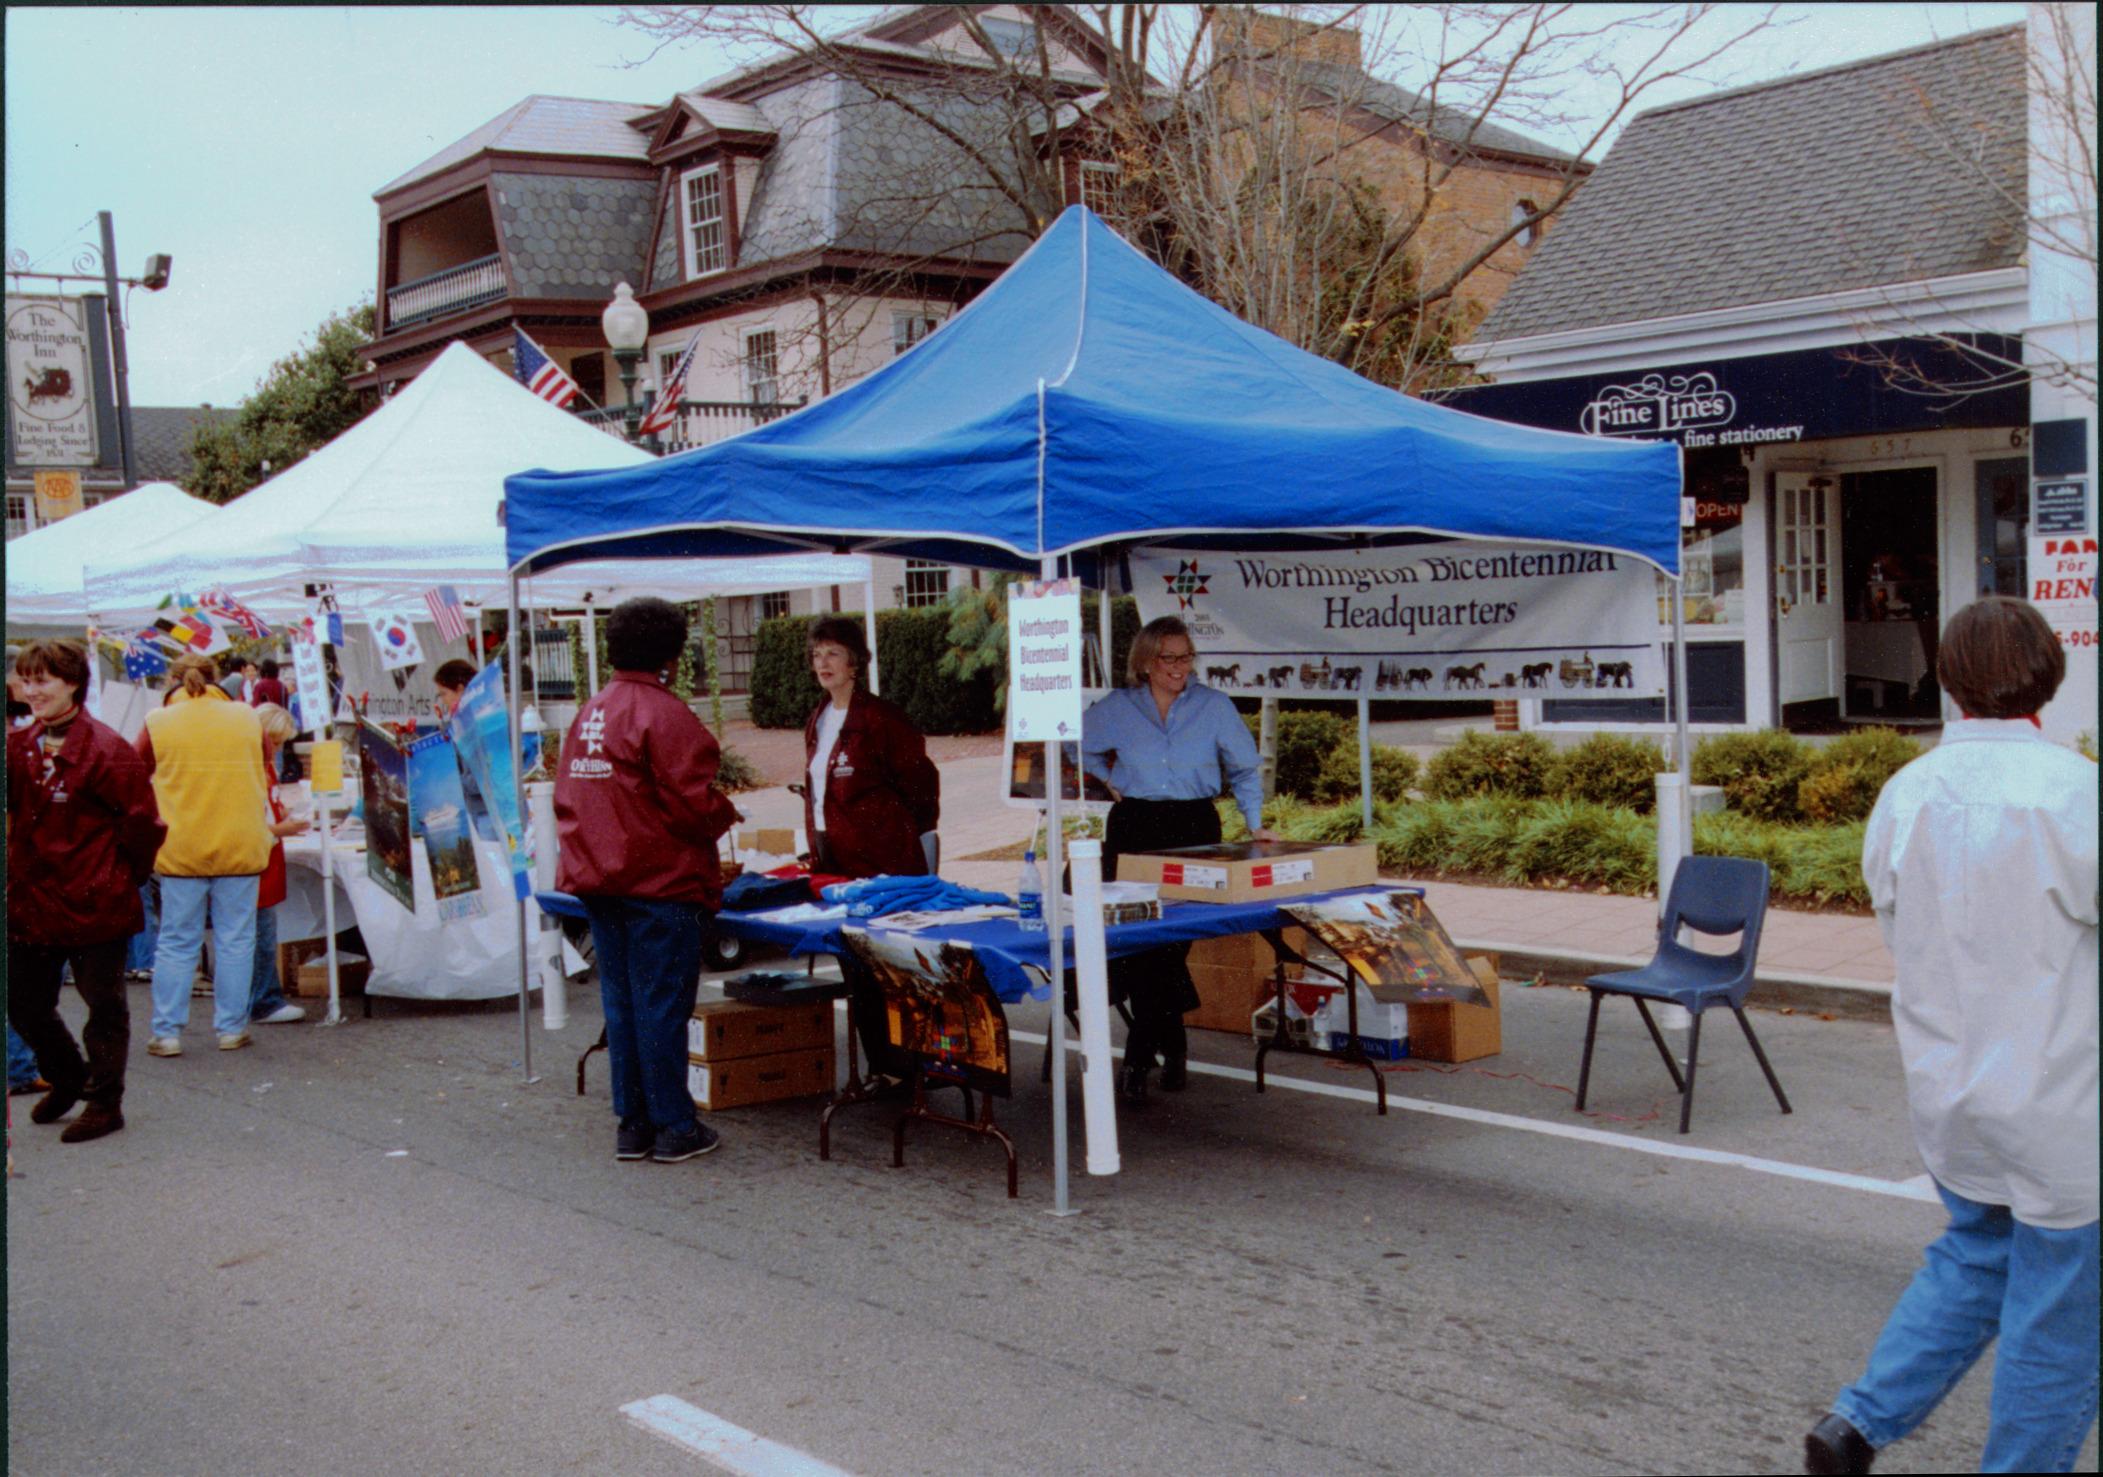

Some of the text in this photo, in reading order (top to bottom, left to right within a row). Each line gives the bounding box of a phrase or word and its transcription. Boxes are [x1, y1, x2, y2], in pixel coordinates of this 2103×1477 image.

[28, 312, 56, 326] The
[7, 328, 81, 348] Worthington
[34, 343, 57, 358] Inn
[1588, 396, 1726, 436] Fine Lines
[18, 422, 43, 433] Fine
[47, 423, 75, 433] Food
[1684, 424, 1804, 449] fine stationery
[18, 435, 58, 448] Lodging
[1871, 438, 1911, 456] 657
[1696, 502, 1739, 518] OPEN
[1235, 551, 1618, 593] Worthington Bicentennial
[2056, 560, 2088, 573] For
[1324, 593, 1517, 635] Headquarters
[1019, 618, 1069, 639] Worthington
[1020, 643, 1070, 665] Bicentennial
[1019, 672, 1073, 694] Headquarters
[407, 693, 431, 716] Arts
